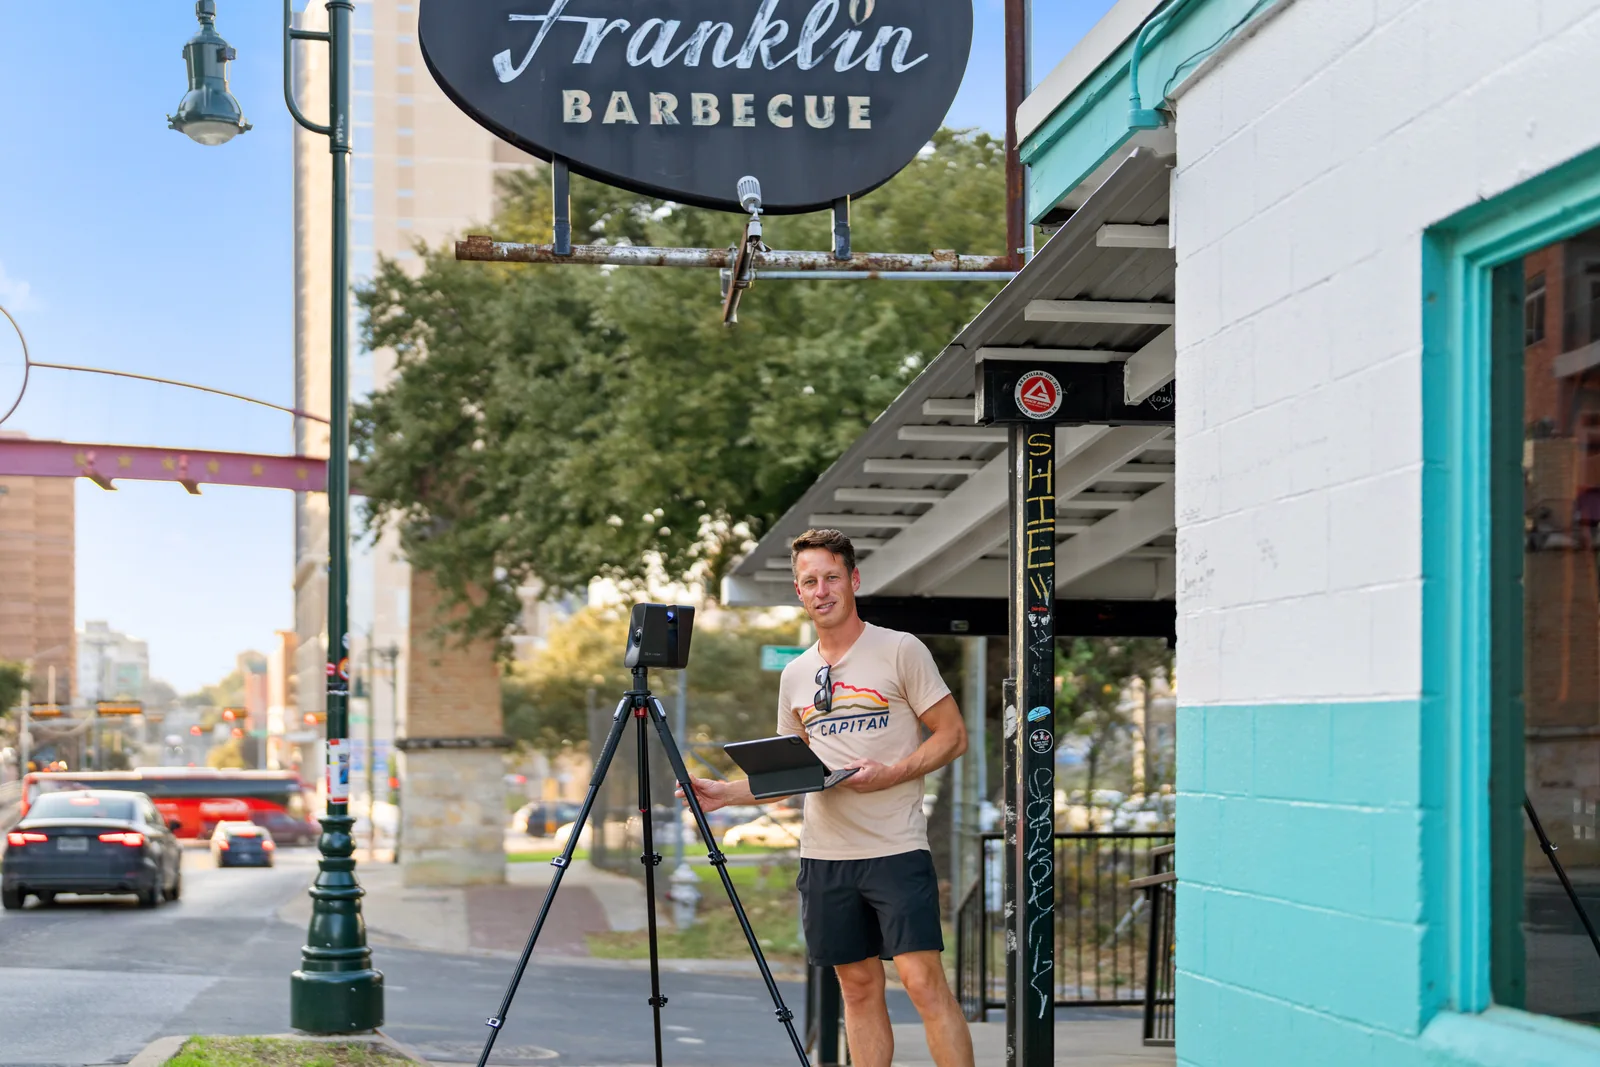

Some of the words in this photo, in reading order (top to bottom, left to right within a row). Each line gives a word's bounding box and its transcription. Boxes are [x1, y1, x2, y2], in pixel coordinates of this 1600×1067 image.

[492, 0, 929, 83] Franklin
[562, 89, 872, 129] BARBECUE
[1018, 372, 1043, 386] BRAZILIAN
[1017, 397, 1029, 414] WEBSTER
[821, 715, 889, 736] CAPITAN
